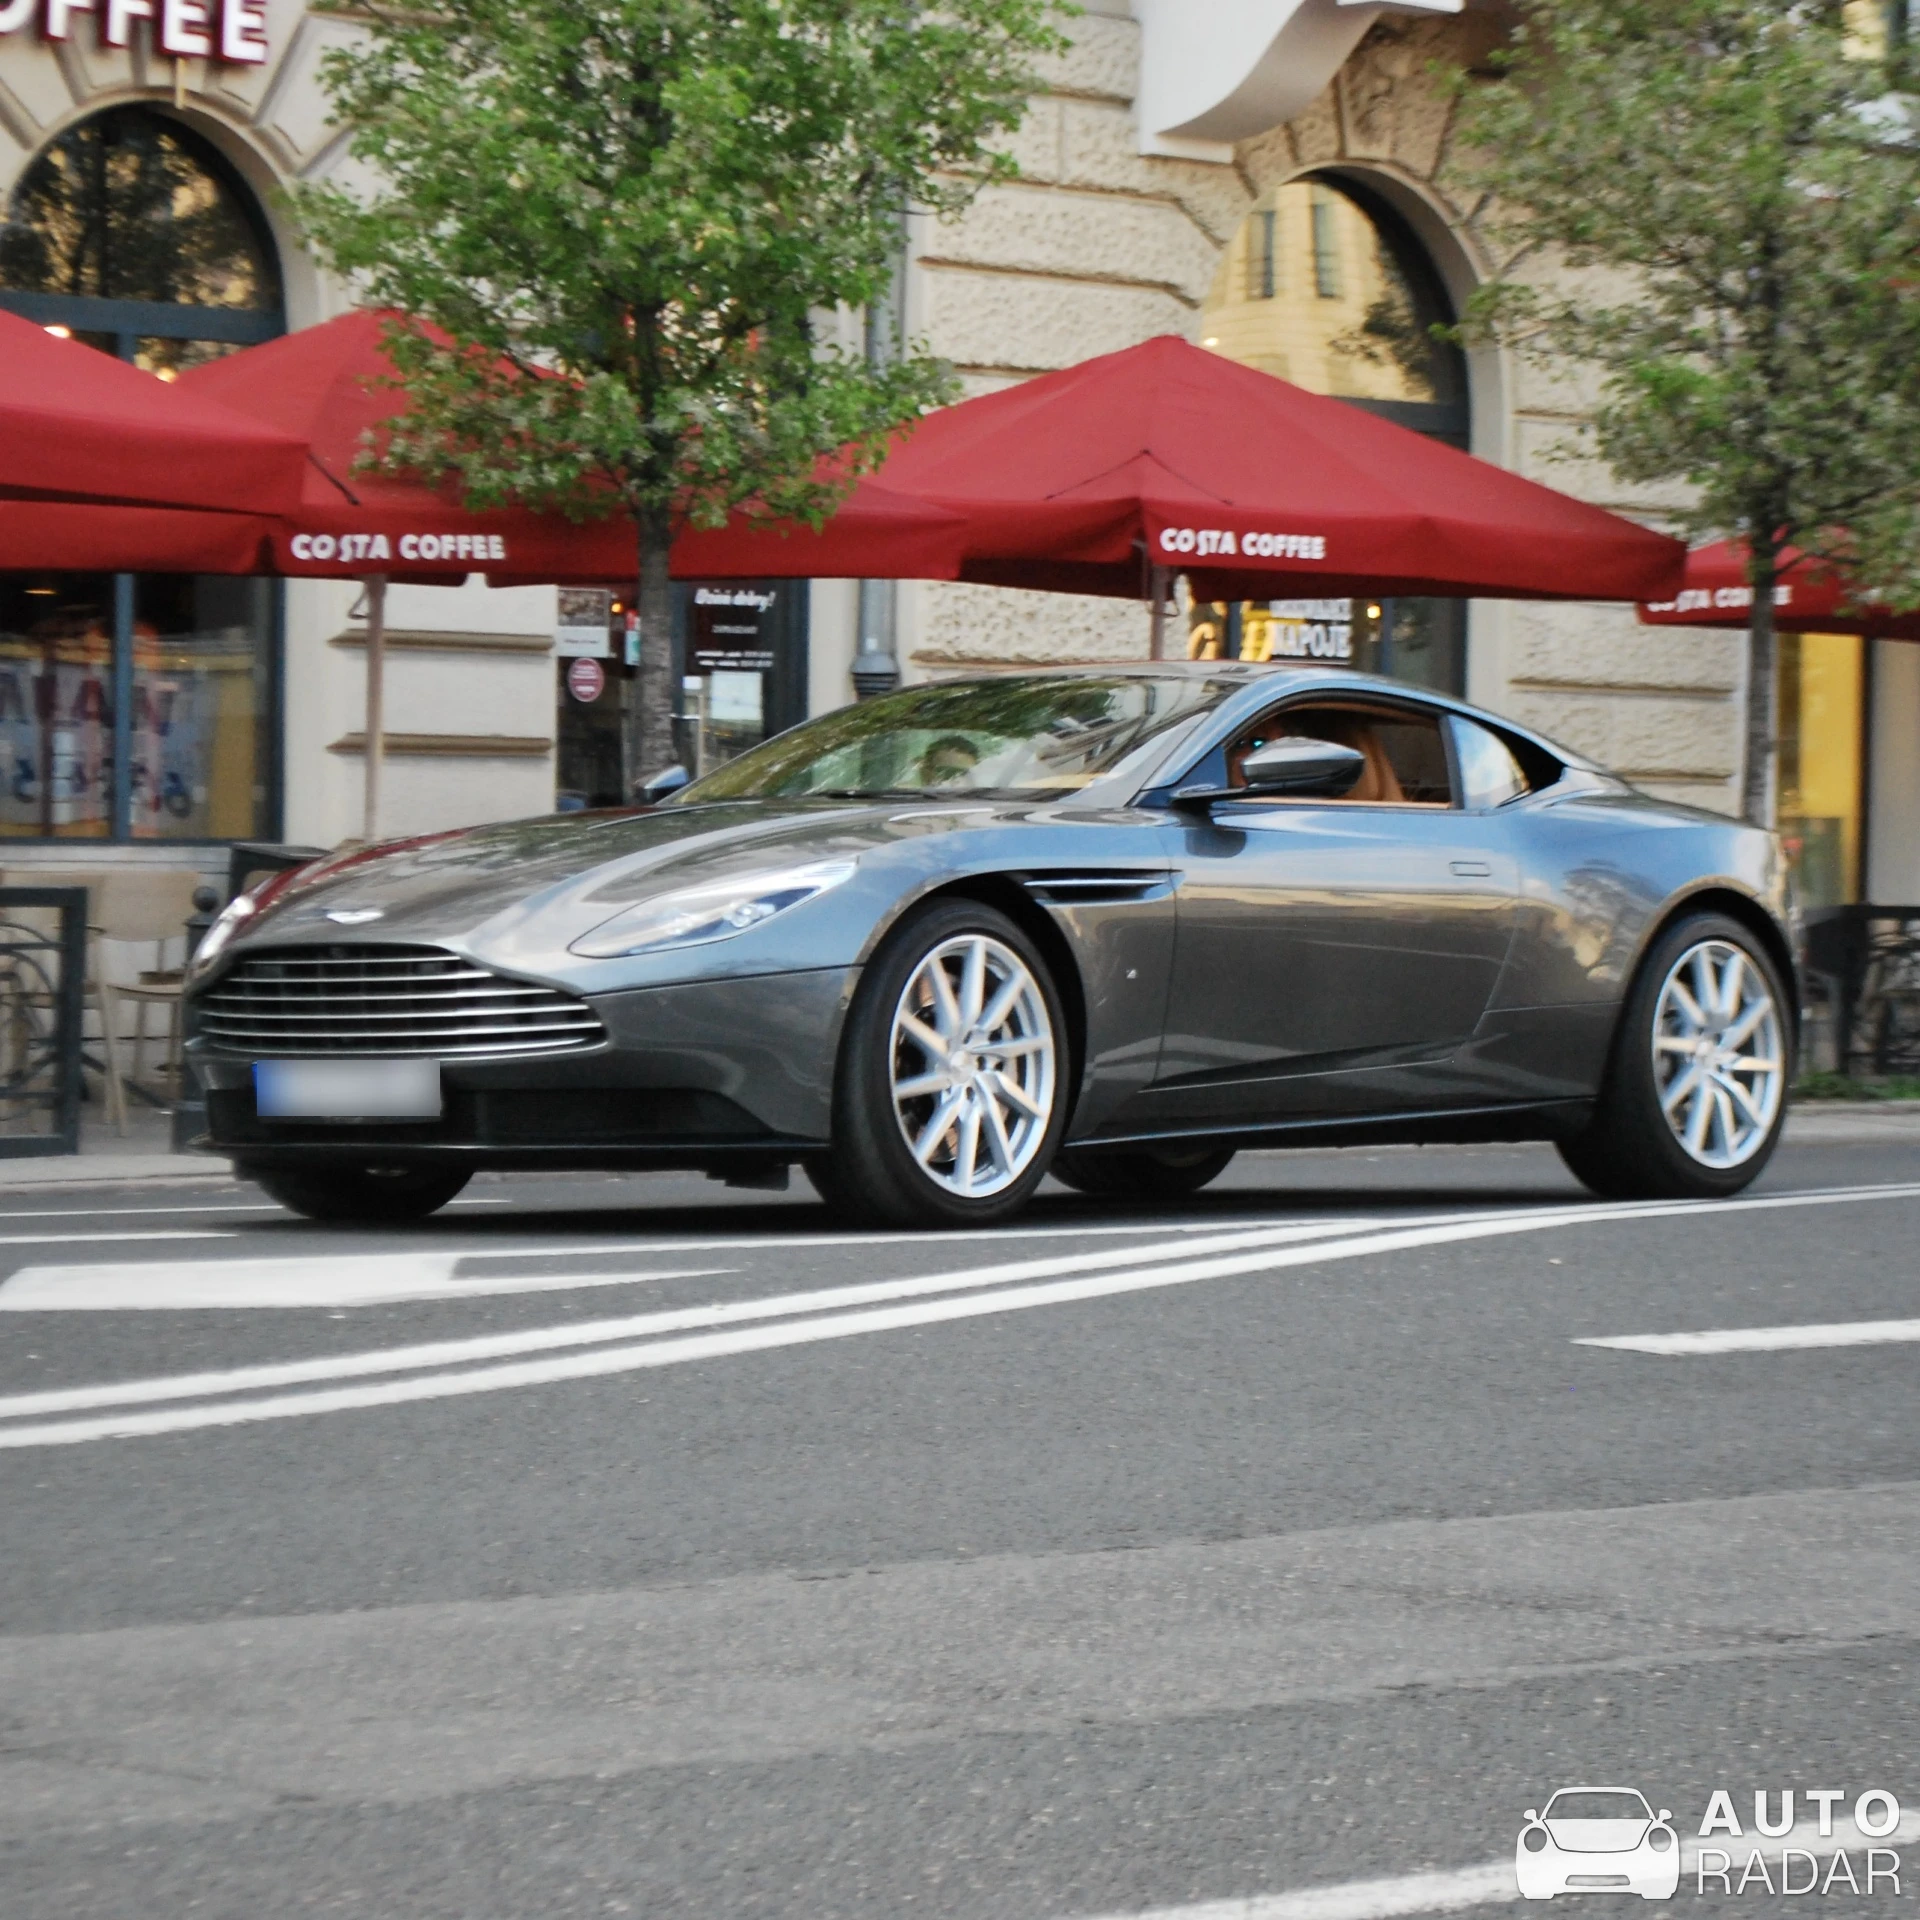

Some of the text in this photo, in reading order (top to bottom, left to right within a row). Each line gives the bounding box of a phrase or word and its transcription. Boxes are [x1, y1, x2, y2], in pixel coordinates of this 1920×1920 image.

[290, 533, 506, 563] COSTA COFFEE
[1159, 527, 1327, 560] COSTA COFFEE
